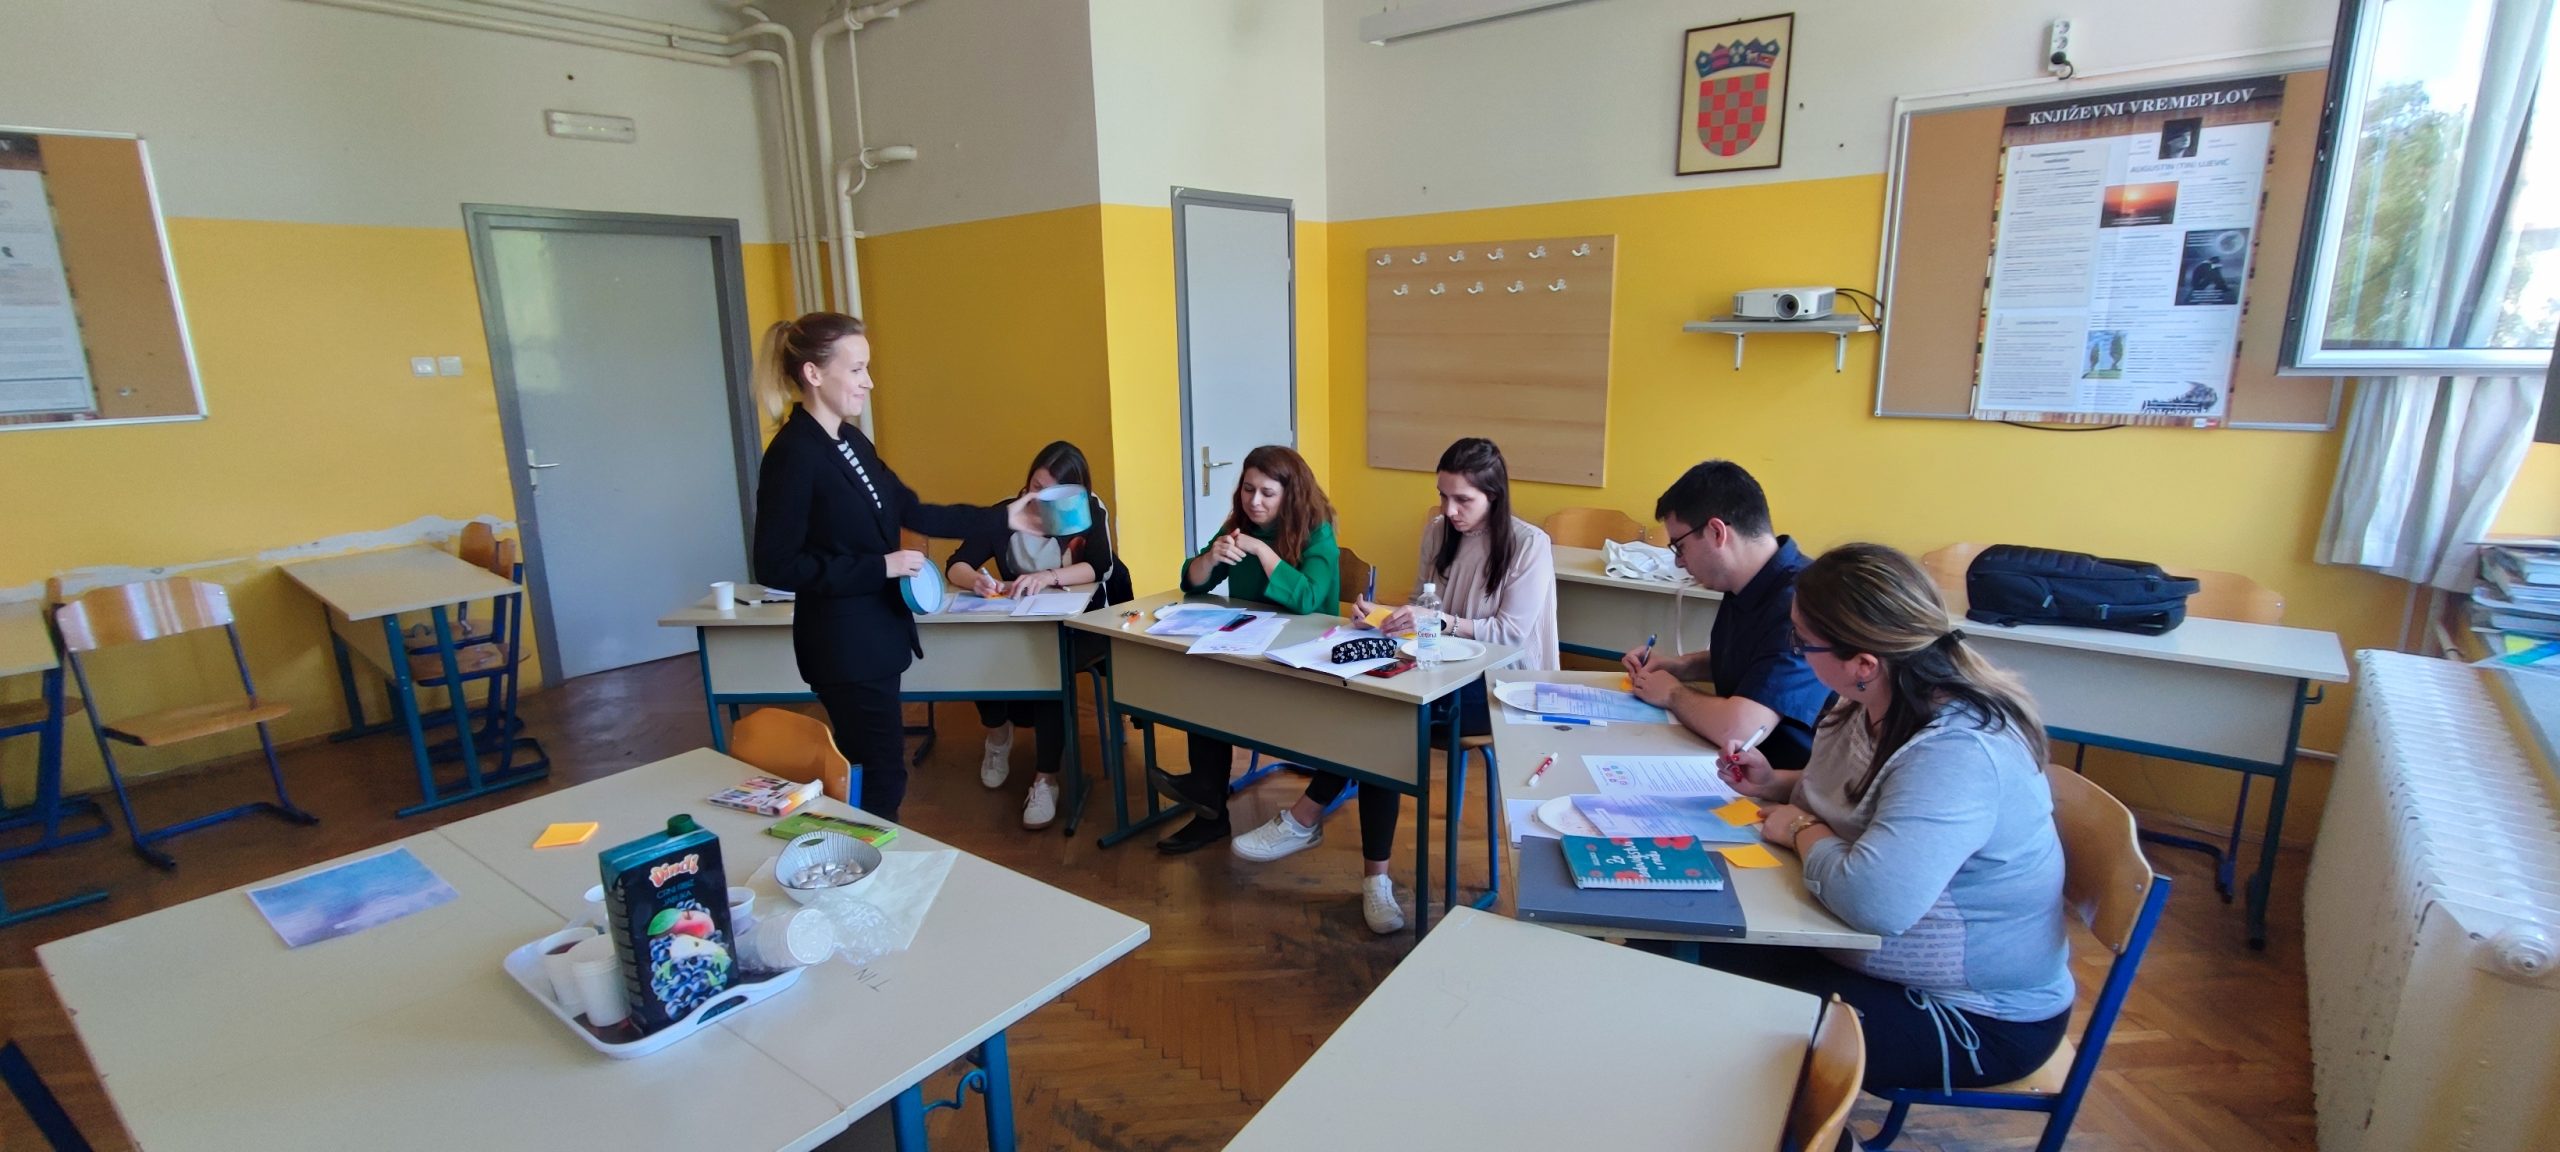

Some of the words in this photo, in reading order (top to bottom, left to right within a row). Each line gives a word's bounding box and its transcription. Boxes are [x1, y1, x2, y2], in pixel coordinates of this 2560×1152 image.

[2028, 103, 2125, 126] KNJIŽEVNI
[2128, 87, 2256, 114] VREMEPLOV
[2129, 163, 2175, 173] AUGUSTIN
[649, 853, 699, 888] Dindi
